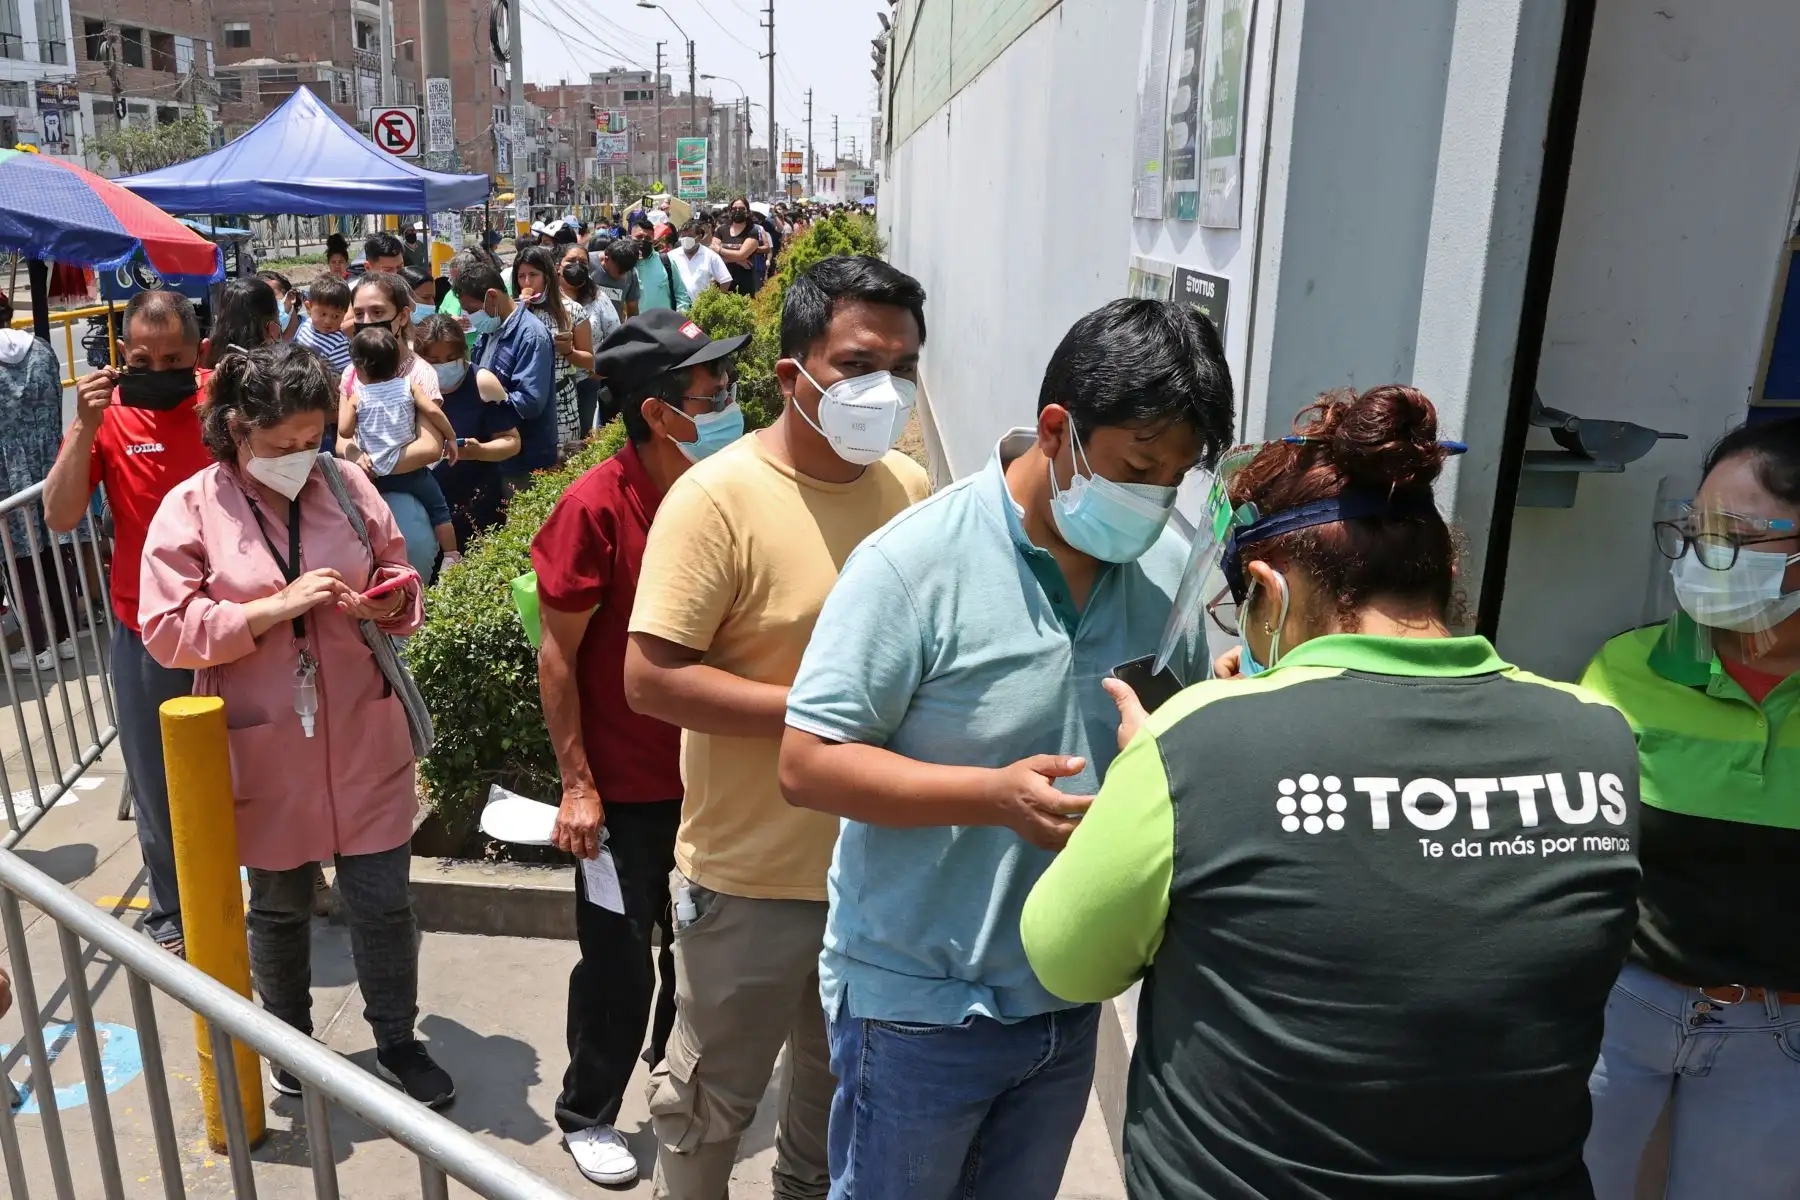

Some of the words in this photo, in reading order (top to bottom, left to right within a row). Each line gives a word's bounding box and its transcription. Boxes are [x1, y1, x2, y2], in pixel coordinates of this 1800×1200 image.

[428, 84, 449, 93] ATRASO
[387, 119, 405, 146] E
[431, 119, 451, 128] ATRASO
[1191, 276, 1215, 298] TOTTUS
[1353, 771, 1627, 831] TOTTUS
[1419, 838, 1443, 858] Te
[1451, 838, 1483, 858] da
[1490, 834, 1536, 856] más
[1542, 837, 1576, 858] por
[1583, 834, 1630, 853] menos
